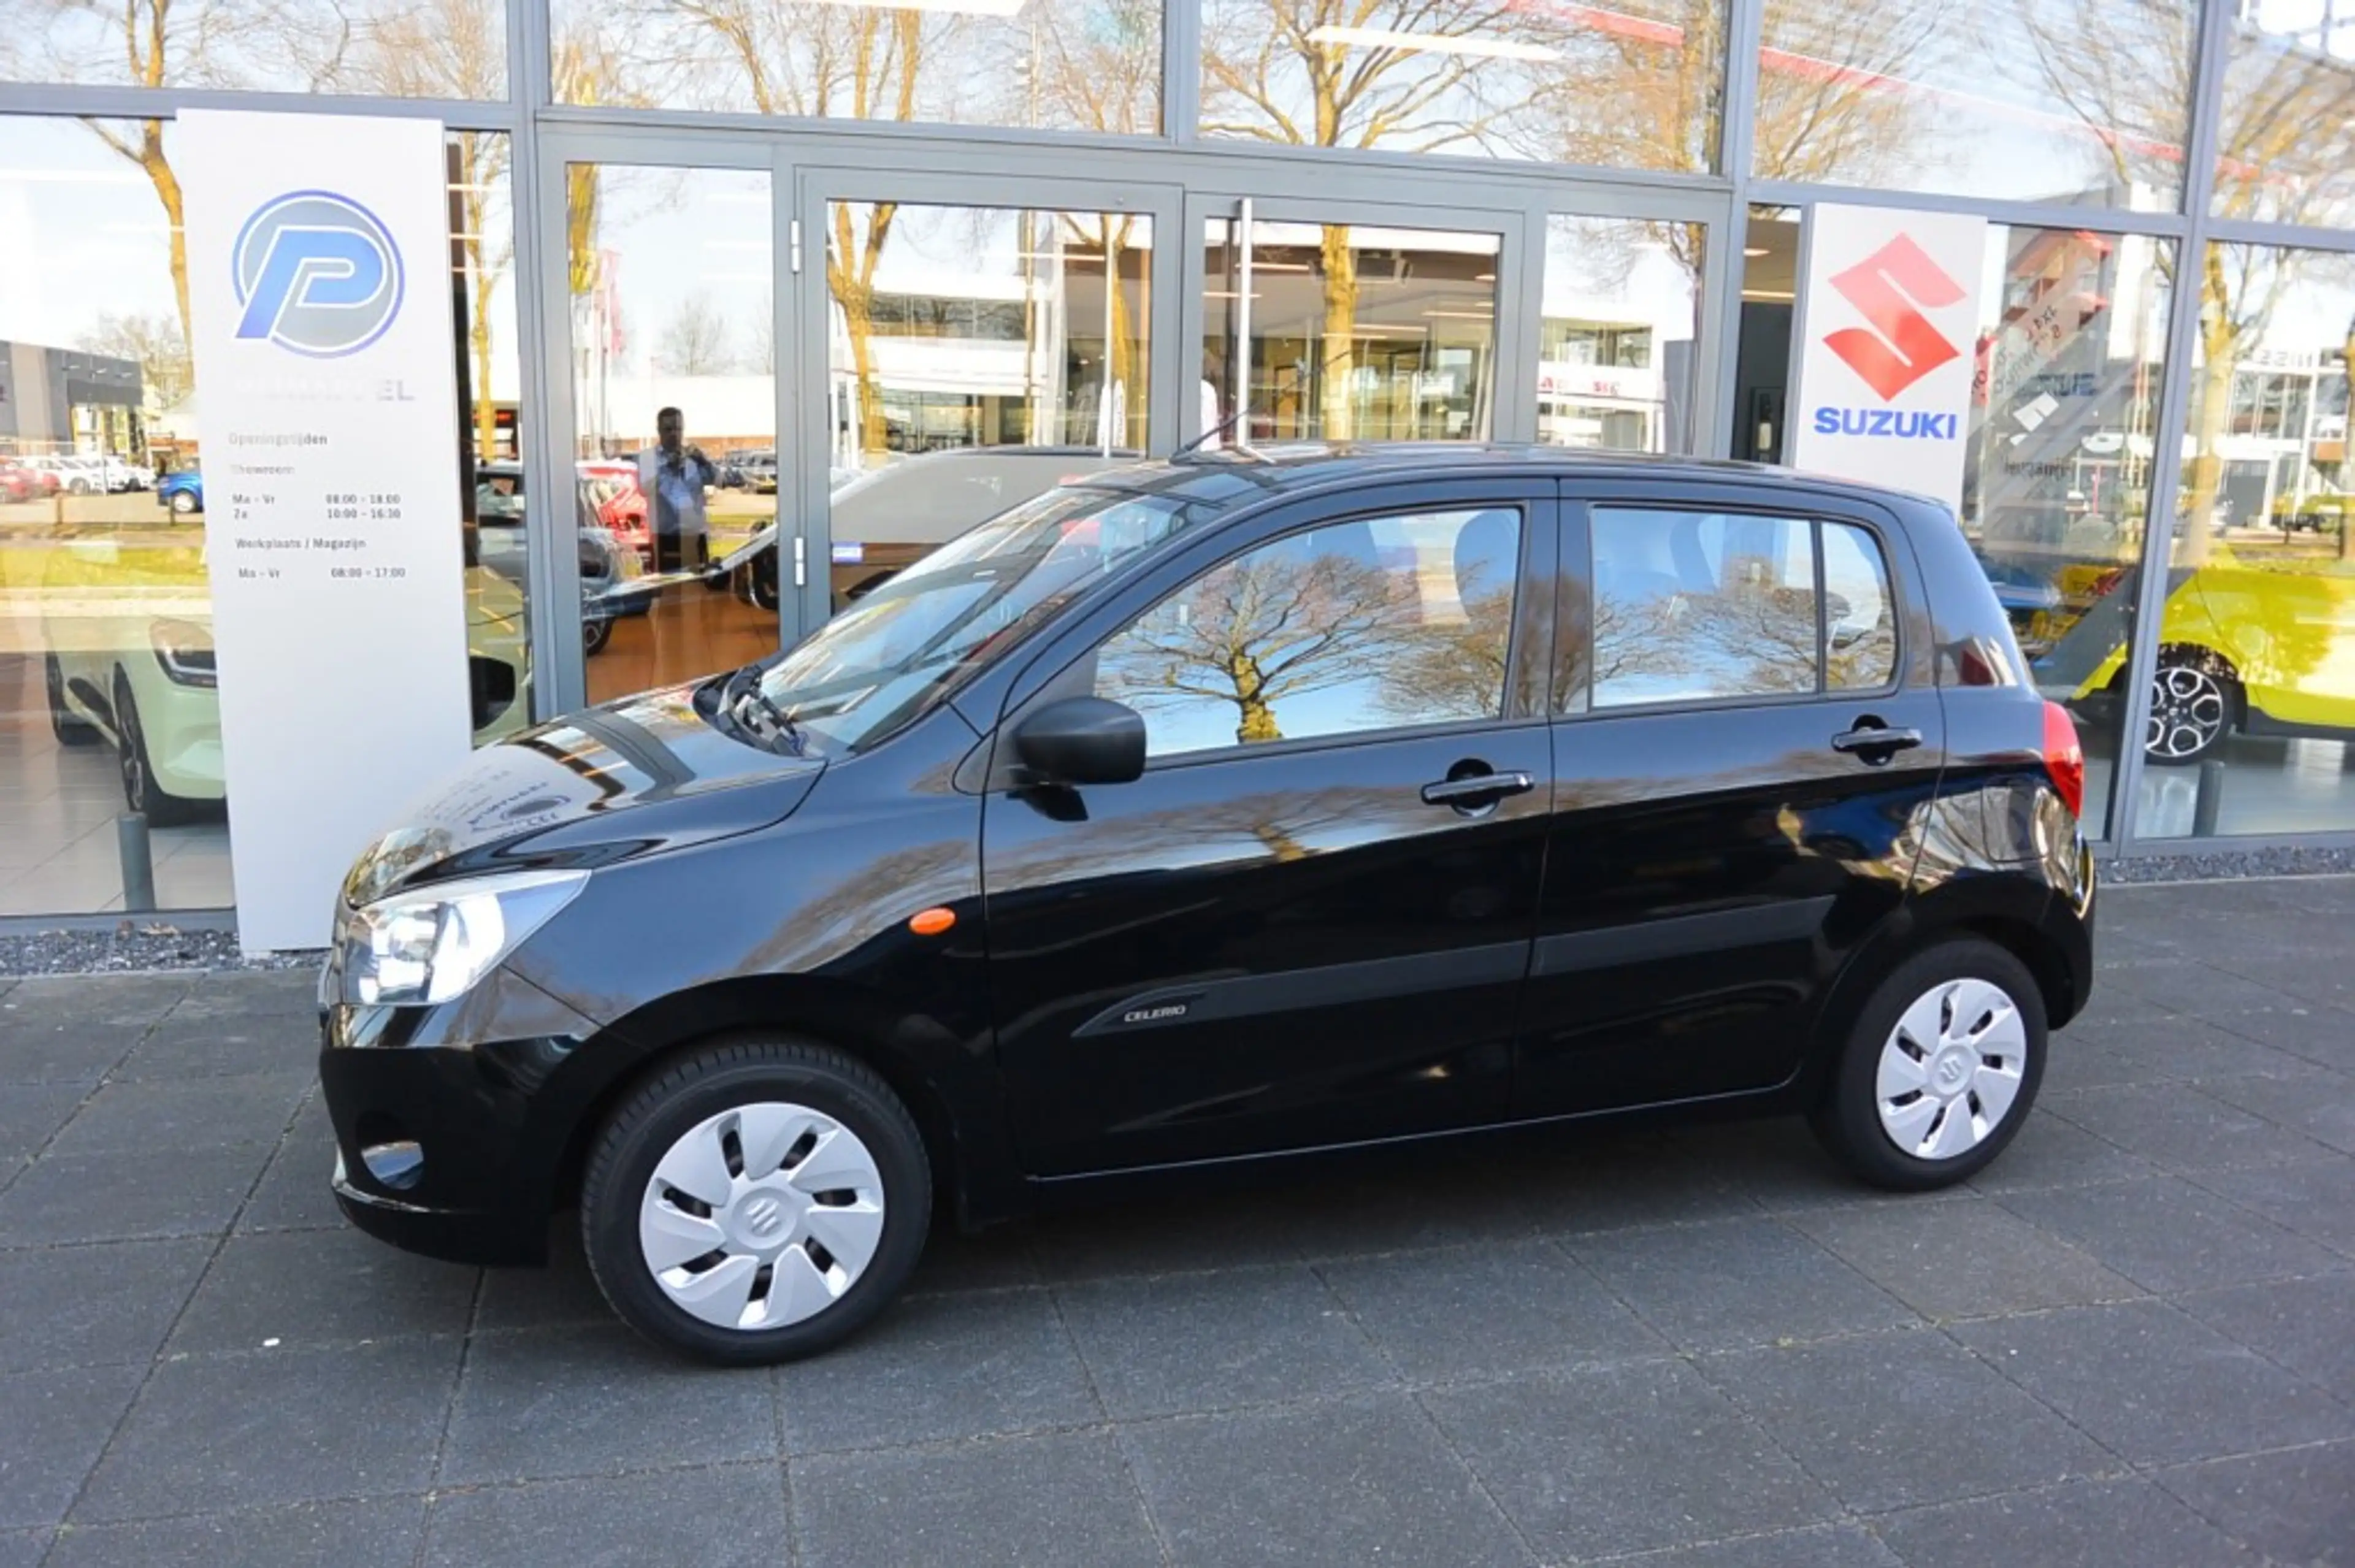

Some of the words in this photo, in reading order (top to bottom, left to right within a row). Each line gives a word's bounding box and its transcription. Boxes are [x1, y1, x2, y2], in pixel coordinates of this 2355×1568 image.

[1814, 407, 1958, 440] SUZUKI
[235, 538, 302, 550] Werkplaats
[313, 538, 367, 551] Magazijn
